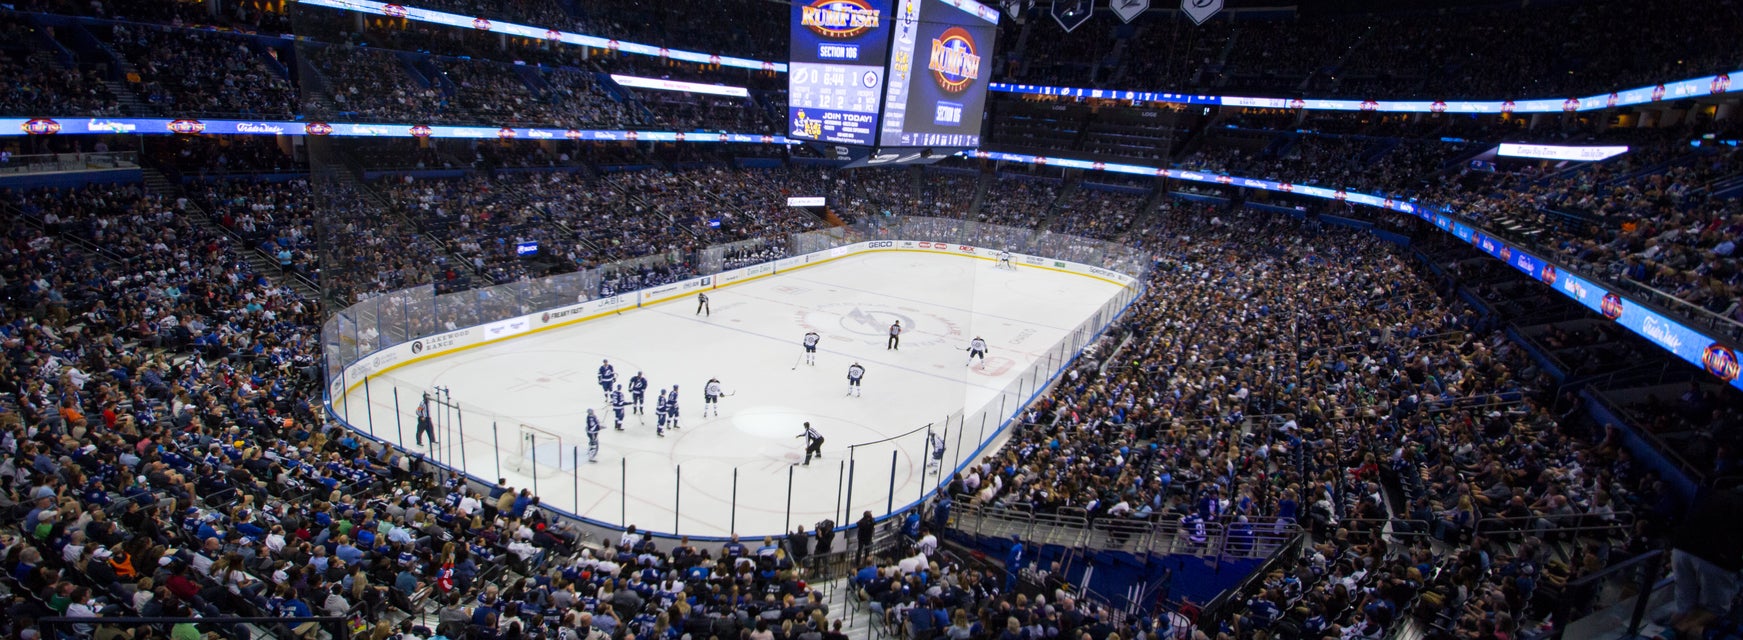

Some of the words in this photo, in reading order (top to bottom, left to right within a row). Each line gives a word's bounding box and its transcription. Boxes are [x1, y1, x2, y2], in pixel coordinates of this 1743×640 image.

[822, 30, 854, 38] GRILL
[820, 46, 845, 58] SECTION
[846, 47, 858, 59] 106
[811, 69, 818, 84] 0
[823, 72, 844, 87] 6:44
[852, 72, 858, 87] 1
[819, 95, 831, 108] 12
[837, 96, 844, 109] 2
[822, 112, 841, 120] JOIN
[842, 113, 872, 123] TODAY!
[868, 240, 893, 249] GEICO
[1089, 266, 1115, 278] Spectrum
[598, 294, 625, 307] JABIL
[551, 308, 570, 320] FREAKY
[426, 329, 470, 345] LAKEWOOD
[426, 339, 455, 351] RANCH
